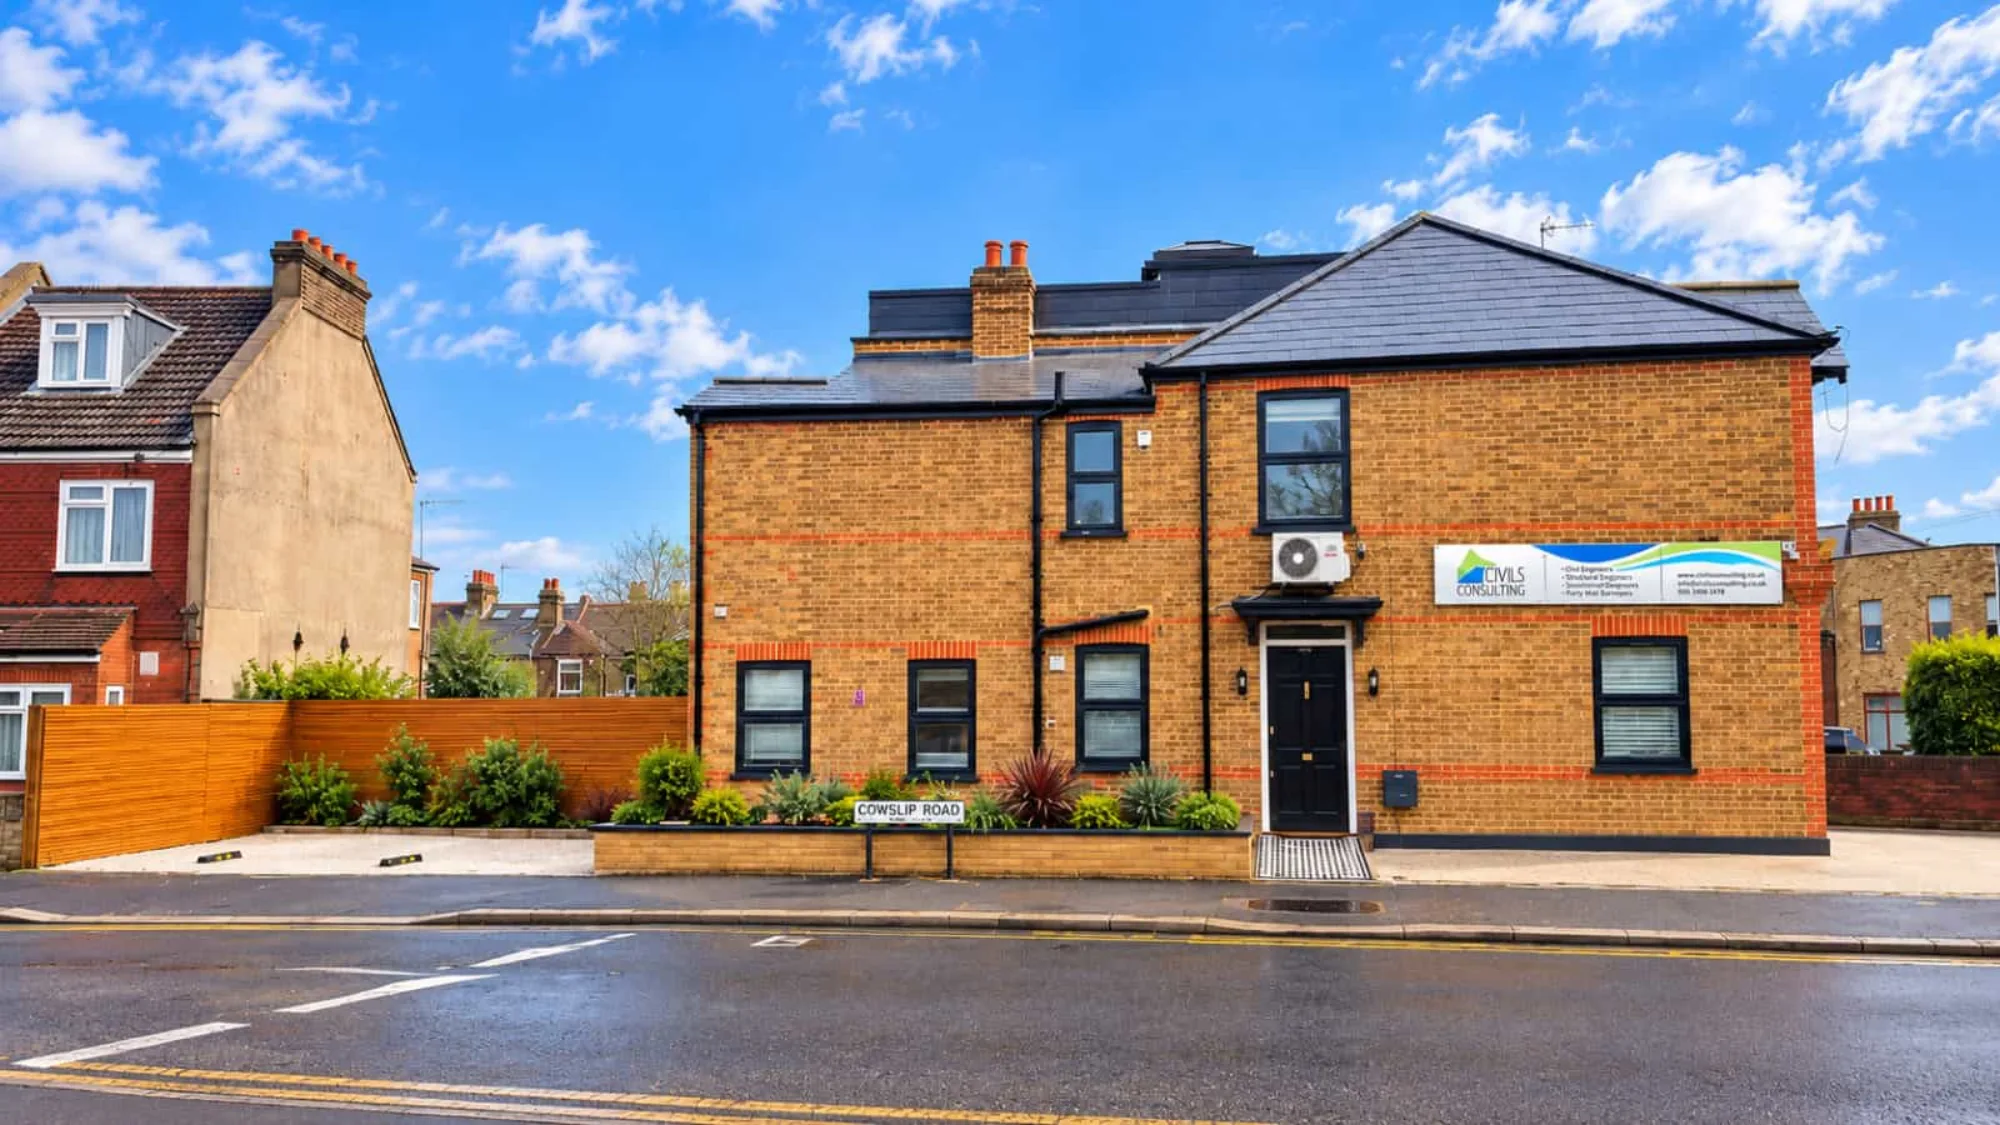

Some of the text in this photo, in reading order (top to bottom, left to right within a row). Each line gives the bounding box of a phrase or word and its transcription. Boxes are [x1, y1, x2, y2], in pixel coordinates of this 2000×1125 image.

[1485, 566, 1525, 583] CIVILS
[1456, 584, 1526, 597] CONSULTING
[857, 803, 960, 816] COWSLIP ROAD
